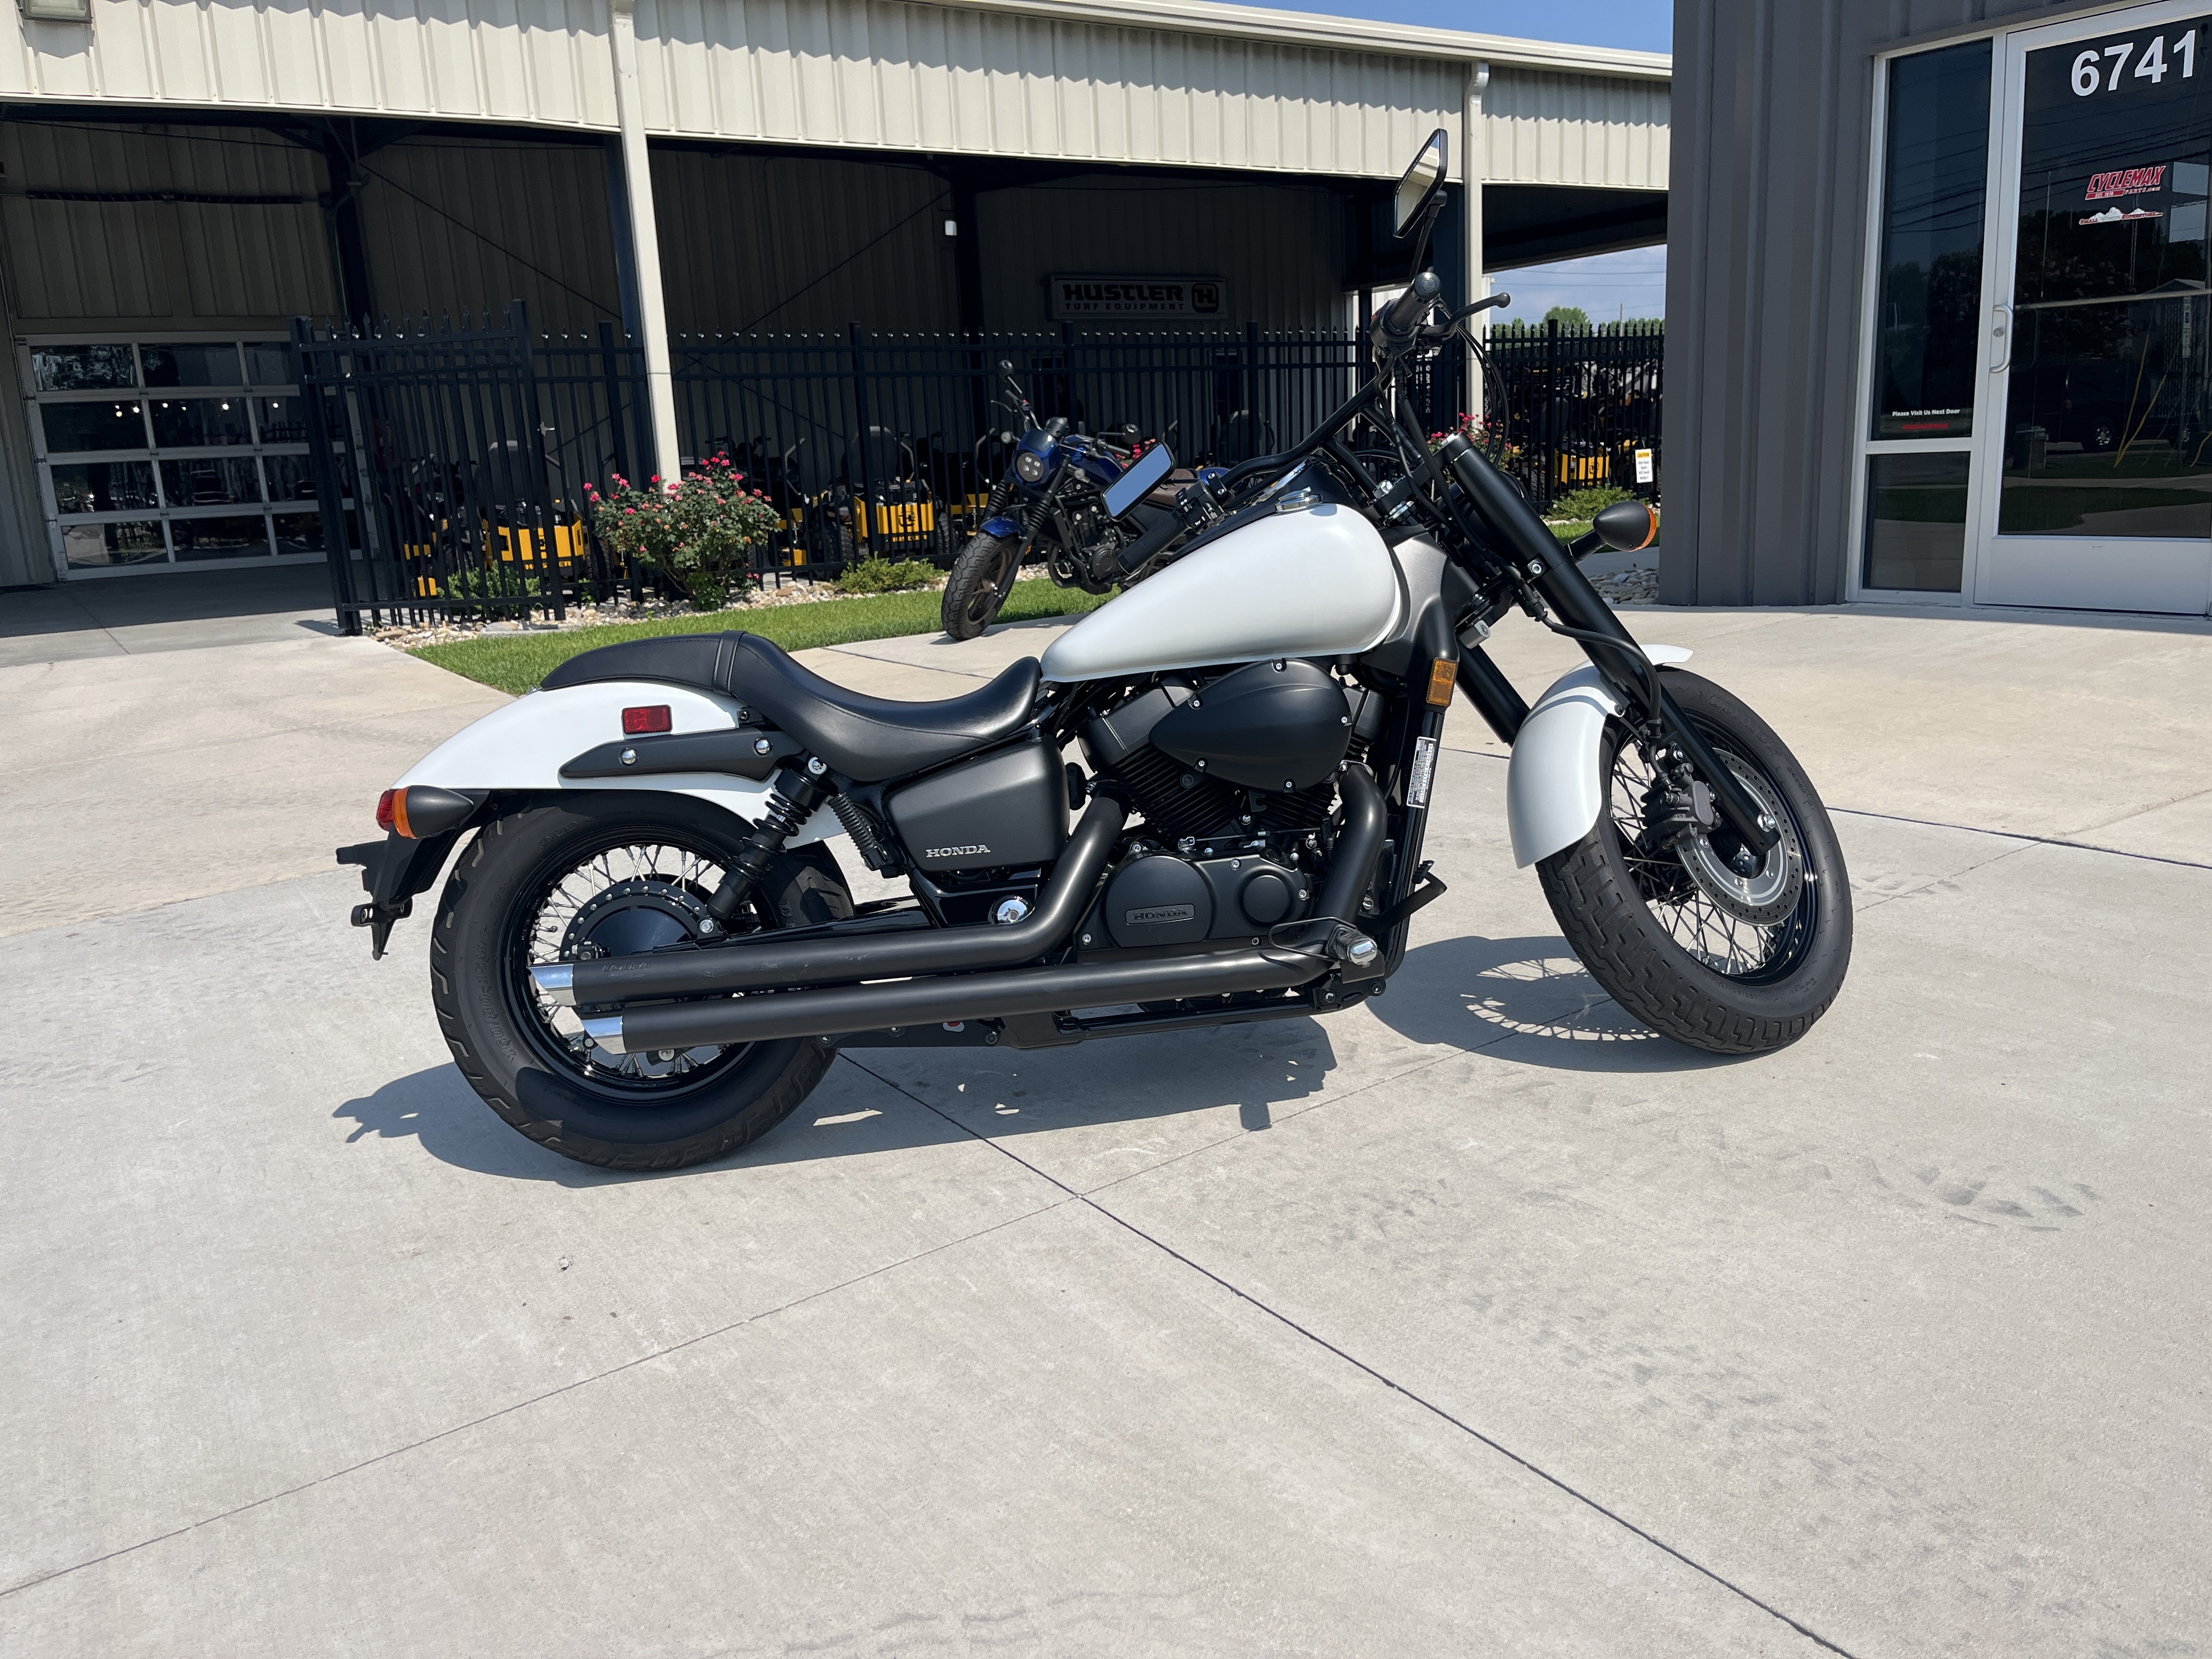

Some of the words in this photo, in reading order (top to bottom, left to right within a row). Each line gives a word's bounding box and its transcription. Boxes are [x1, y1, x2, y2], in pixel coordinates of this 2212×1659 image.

[2071, 30, 2196, 96] 6741
[2087, 165, 2166, 193] CYCLEMAX
[1063, 284, 1184, 301] HUSTLER
[926, 845, 990, 859] HONDA
[1132, 908, 1188, 922] HONDA
